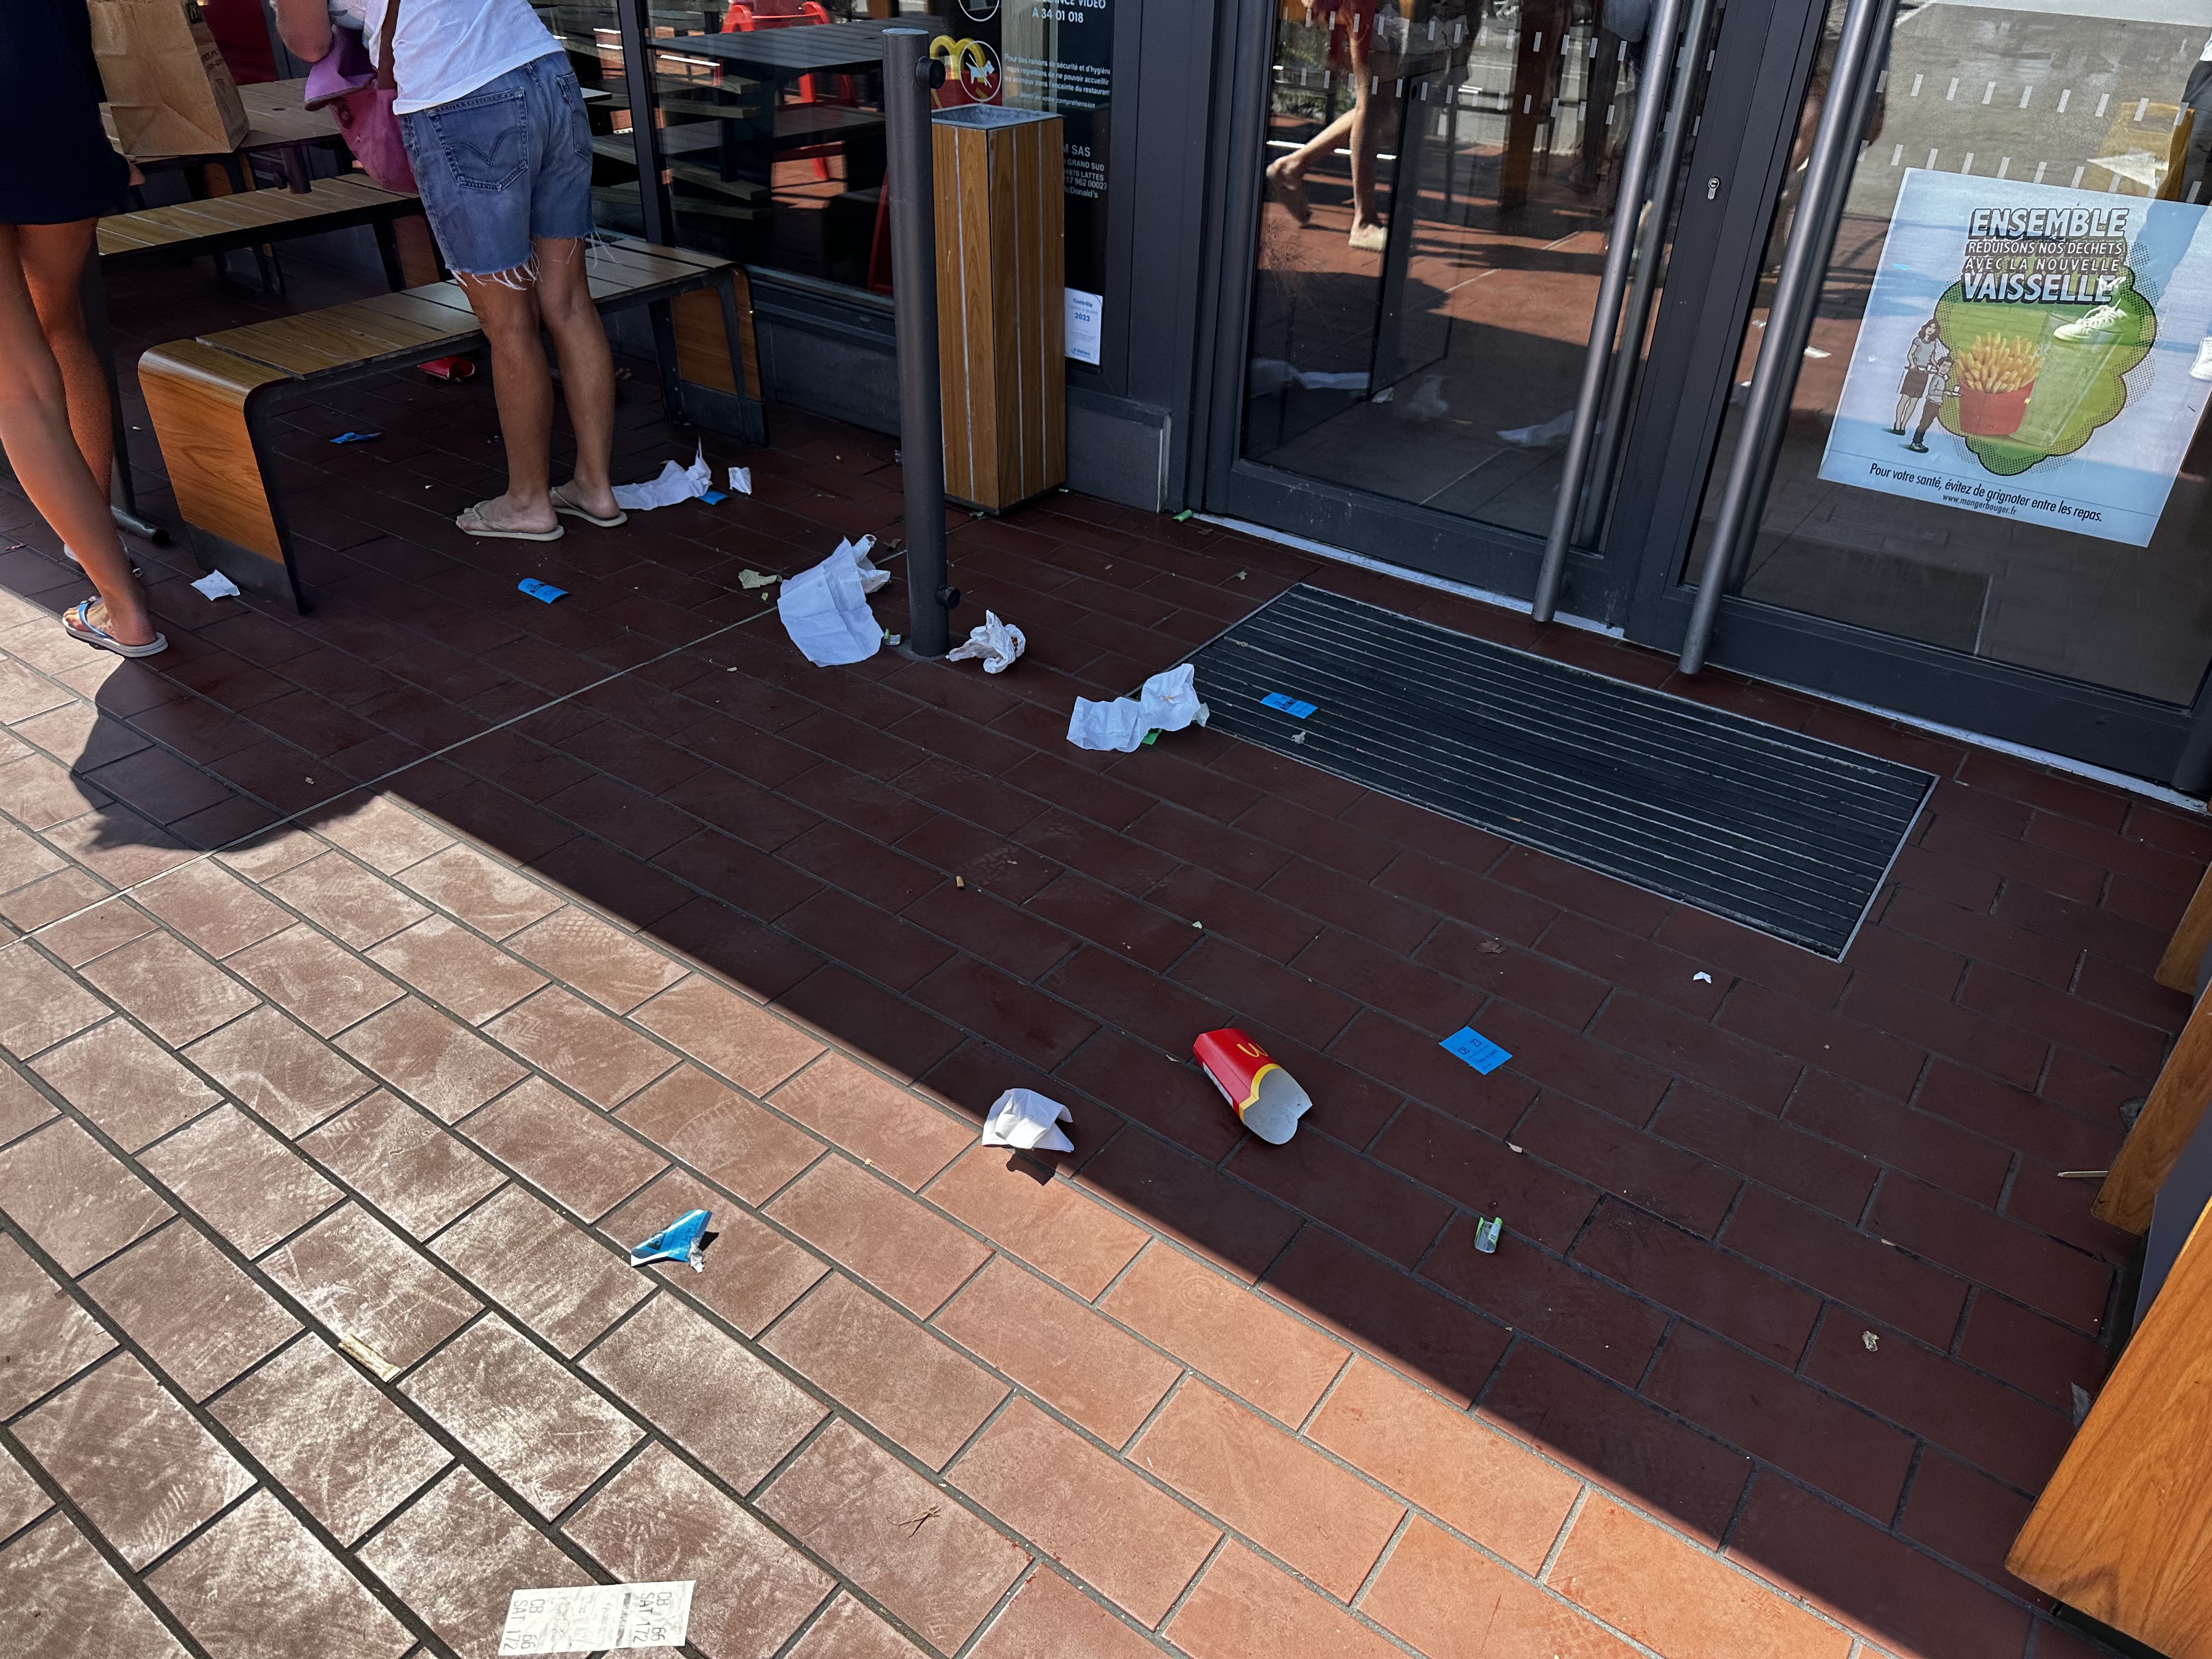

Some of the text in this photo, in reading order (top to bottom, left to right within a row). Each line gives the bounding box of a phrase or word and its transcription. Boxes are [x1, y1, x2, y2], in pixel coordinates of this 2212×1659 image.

[1032, 7, 1084, 23] A 34 01 018
[1005, 53, 1017, 61] Pour
[1029, 58, 1048, 66] raisons
[1057, 61, 1078, 70] sécurité
[1020, 68, 1047, 77] regrettons
[1085, 77, 1109, 85] accueillir
[1049, 81, 1074, 91] l'enceinte
[1056, 98, 1096, 109] compréhension
[1071, 144, 1091, 157] SAS
[1067, 159, 1104, 171] GRAND SUD
[1074, 177, 1087, 187] 962
[1088, 180, 1108, 190] 00027
[1081, 171, 1104, 182] LATTES
[1968, 207, 2130, 240] ENSEMBLE
[2038, 242, 2064, 255] NOS
[1965, 257, 2120, 272] AVEC LA NOUVELLE
[1962, 273, 2117, 304] VAISSELLE
[1073, 298, 1093, 307] Contrôle
[1075, 312, 1090, 321] 2023
[1870, 463, 2102, 521] Pour votre santé, évitez de grignoter entre les repas.
[1943, 494, 2017, 515] www.mangerbouger.fr
[521, 1599, 545, 1649] CB 66
[633, 1593, 655, 1643] SAT 172
[650, 1592, 672, 1641] CB 66
[503, 1600, 528, 1650] SAT 172
